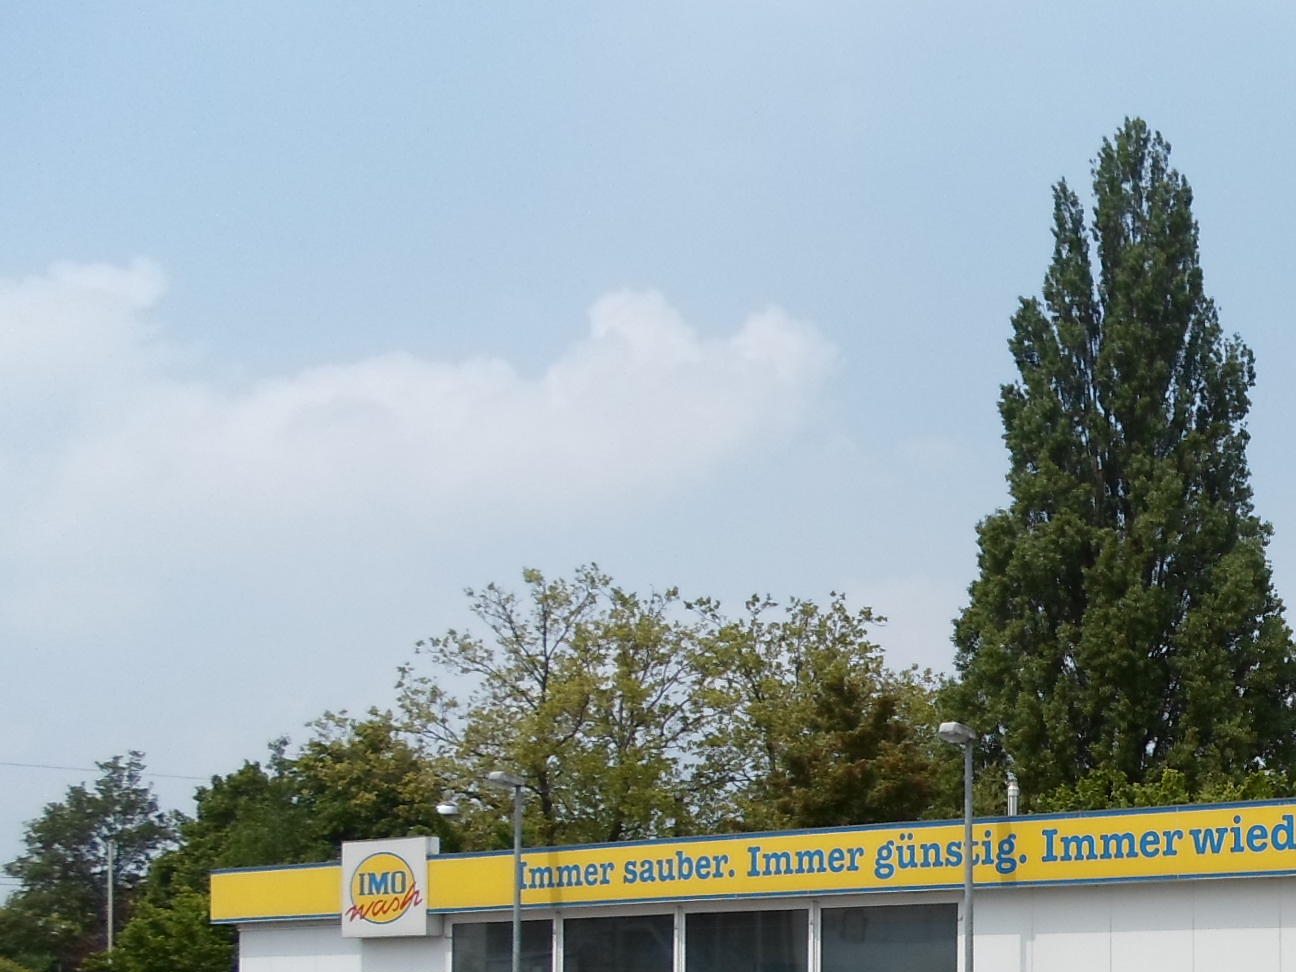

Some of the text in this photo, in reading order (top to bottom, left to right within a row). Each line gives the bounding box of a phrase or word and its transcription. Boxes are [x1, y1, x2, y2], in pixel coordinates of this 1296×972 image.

[518, 861, 615, 889] Immer
[623, 850, 736, 884] sauber.
[746, 846, 864, 877] Immer
[1041, 829, 1184, 862] Immer
[344, 881, 423, 922] wash
[358, 870, 407, 896] IMO
